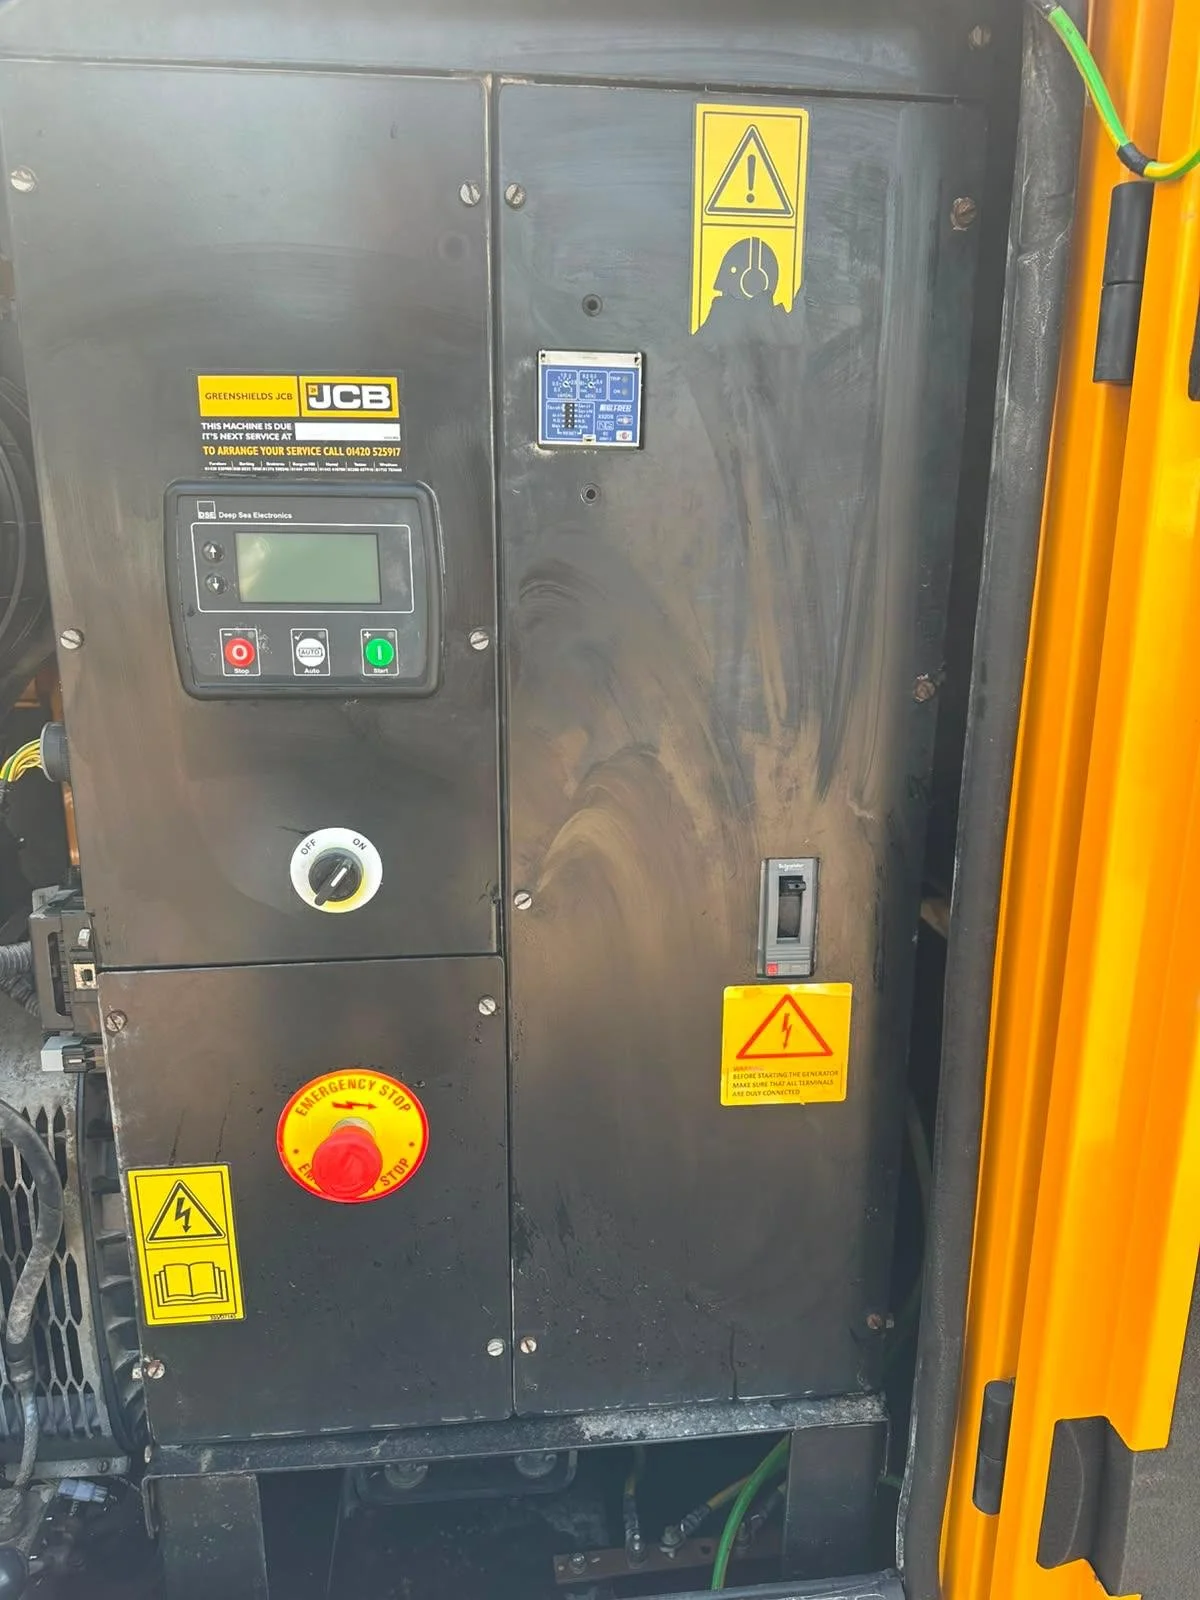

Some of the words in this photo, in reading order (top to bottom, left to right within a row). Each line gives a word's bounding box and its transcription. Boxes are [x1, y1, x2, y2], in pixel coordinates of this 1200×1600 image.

[205, 392, 273, 401] GREENSHIELDS
[275, 392, 293, 401] JCB
[308, 384, 391, 410] JCB
[200, 422, 222, 431] THIS
[222, 422, 263, 431] MACHINE
[264, 422, 273, 431] IS
[273, 422, 292, 431] DUE
[202, 432, 219, 440] IT'S
[219, 432, 244, 440] NEXT
[245, 432, 280, 441] SERVICE
[281, 432, 293, 441] AT
[202, 445, 216, 456] TO
[217, 446, 259, 456] ARRANGE
[259, 446, 285, 456] YOUR
[286, 446, 322, 456] SERVICE
[323, 446, 345, 457] CALL
[345, 447, 371, 457] 01420
[372, 447, 401, 457] 525917
[198, 511, 216, 519] DSE
[218, 511, 237, 520] Deep
[238, 511, 252, 519] Sea
[252, 511, 293, 519] Electronics
[300, 649, 320, 657] AUTO
[234, 667, 250, 675] Stop
[301, 838, 317, 855] OFF
[352, 838, 368, 851] ON
[801, 1070, 839, 1078] GENERATOR
[295, 1078, 377, 1117] EMERGENCY
[378, 1084, 412, 1113] STOP
[380, 1157, 410, 1187] STOP
